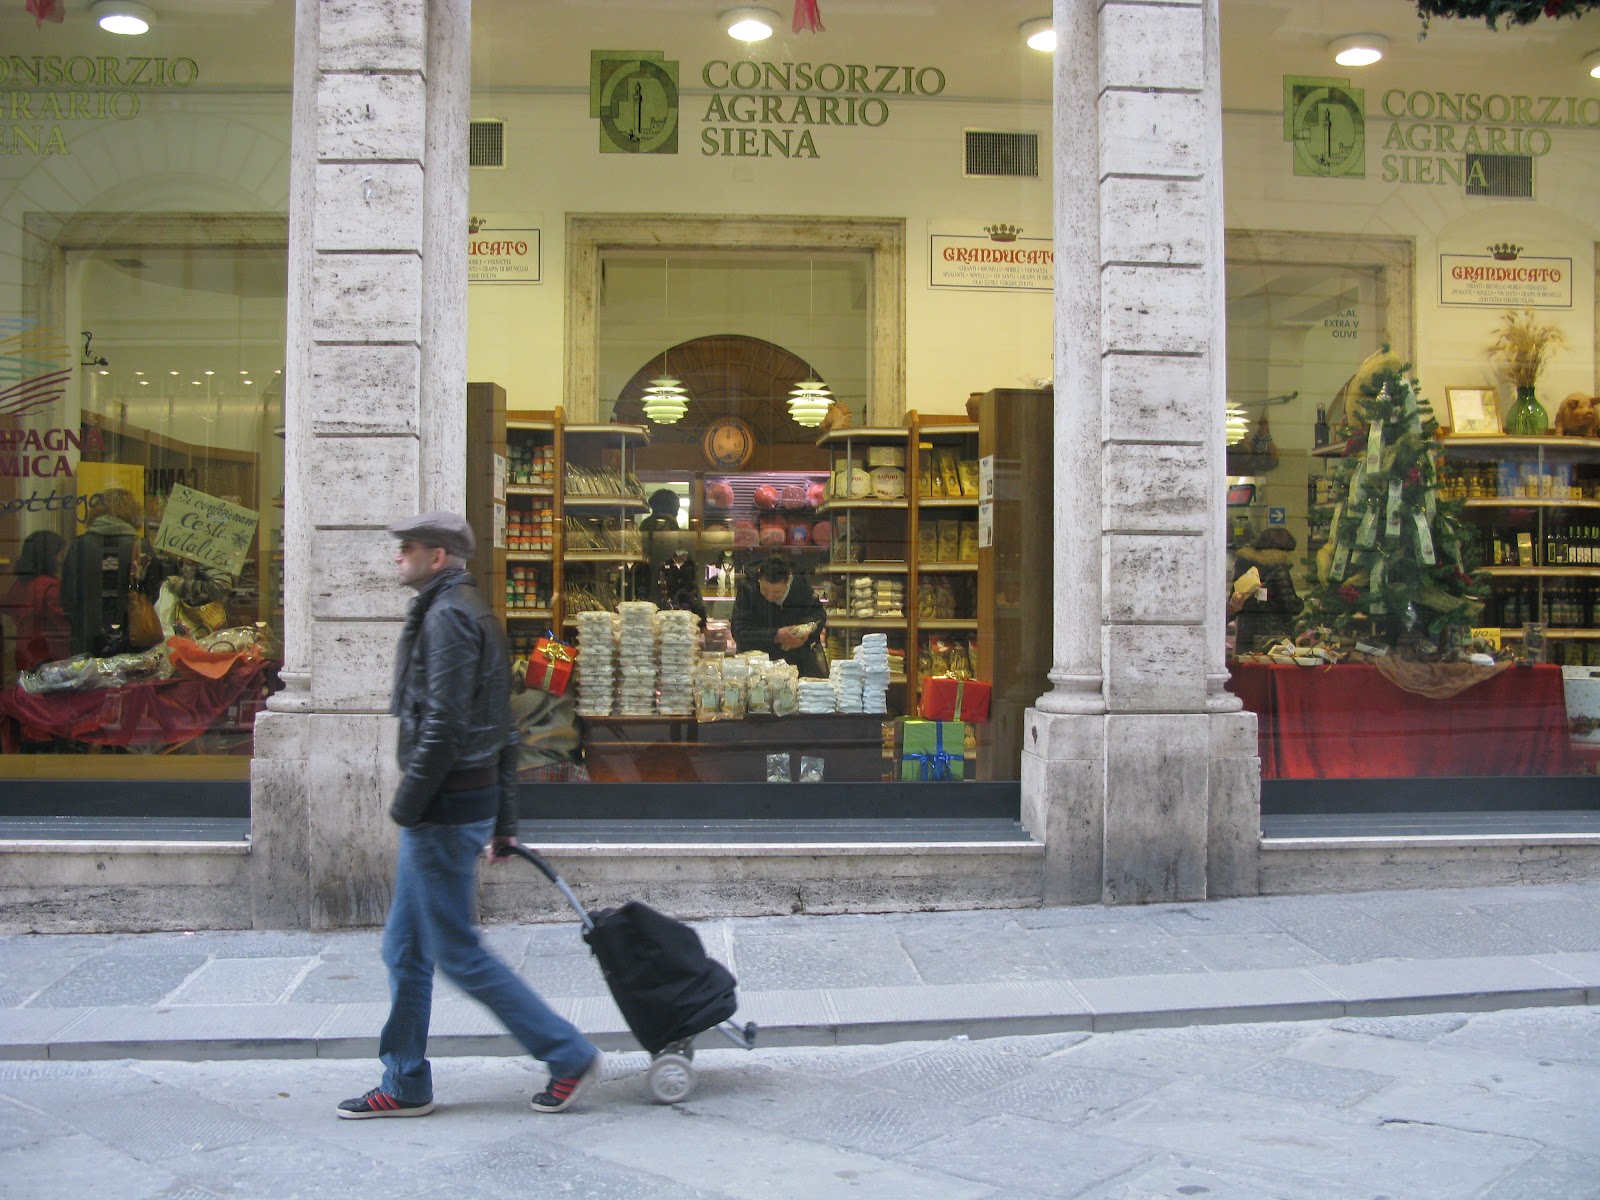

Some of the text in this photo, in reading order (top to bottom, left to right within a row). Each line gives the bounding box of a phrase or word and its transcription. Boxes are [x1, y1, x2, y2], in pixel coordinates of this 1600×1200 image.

[701, 60, 946, 96] CONSORZIO
[0, 90, 141, 120] RARIO
[701, 94, 889, 127] AGRARIO
[1381, 89, 1600, 127] CONSORZIO
[701, 127, 820, 158] SIENA
[1381, 121, 1552, 157] AGRARIO
[1381, 154, 1489, 187] SIENA
[943, 247, 1054, 265] GRANDUCAT
[1451, 266, 1561, 283] GRANDUCATO
[1324, 319, 1351, 328] EXTRA
[1332, 330, 1358, 339] OLIVE
[0, 489, 105, 523] ottega
